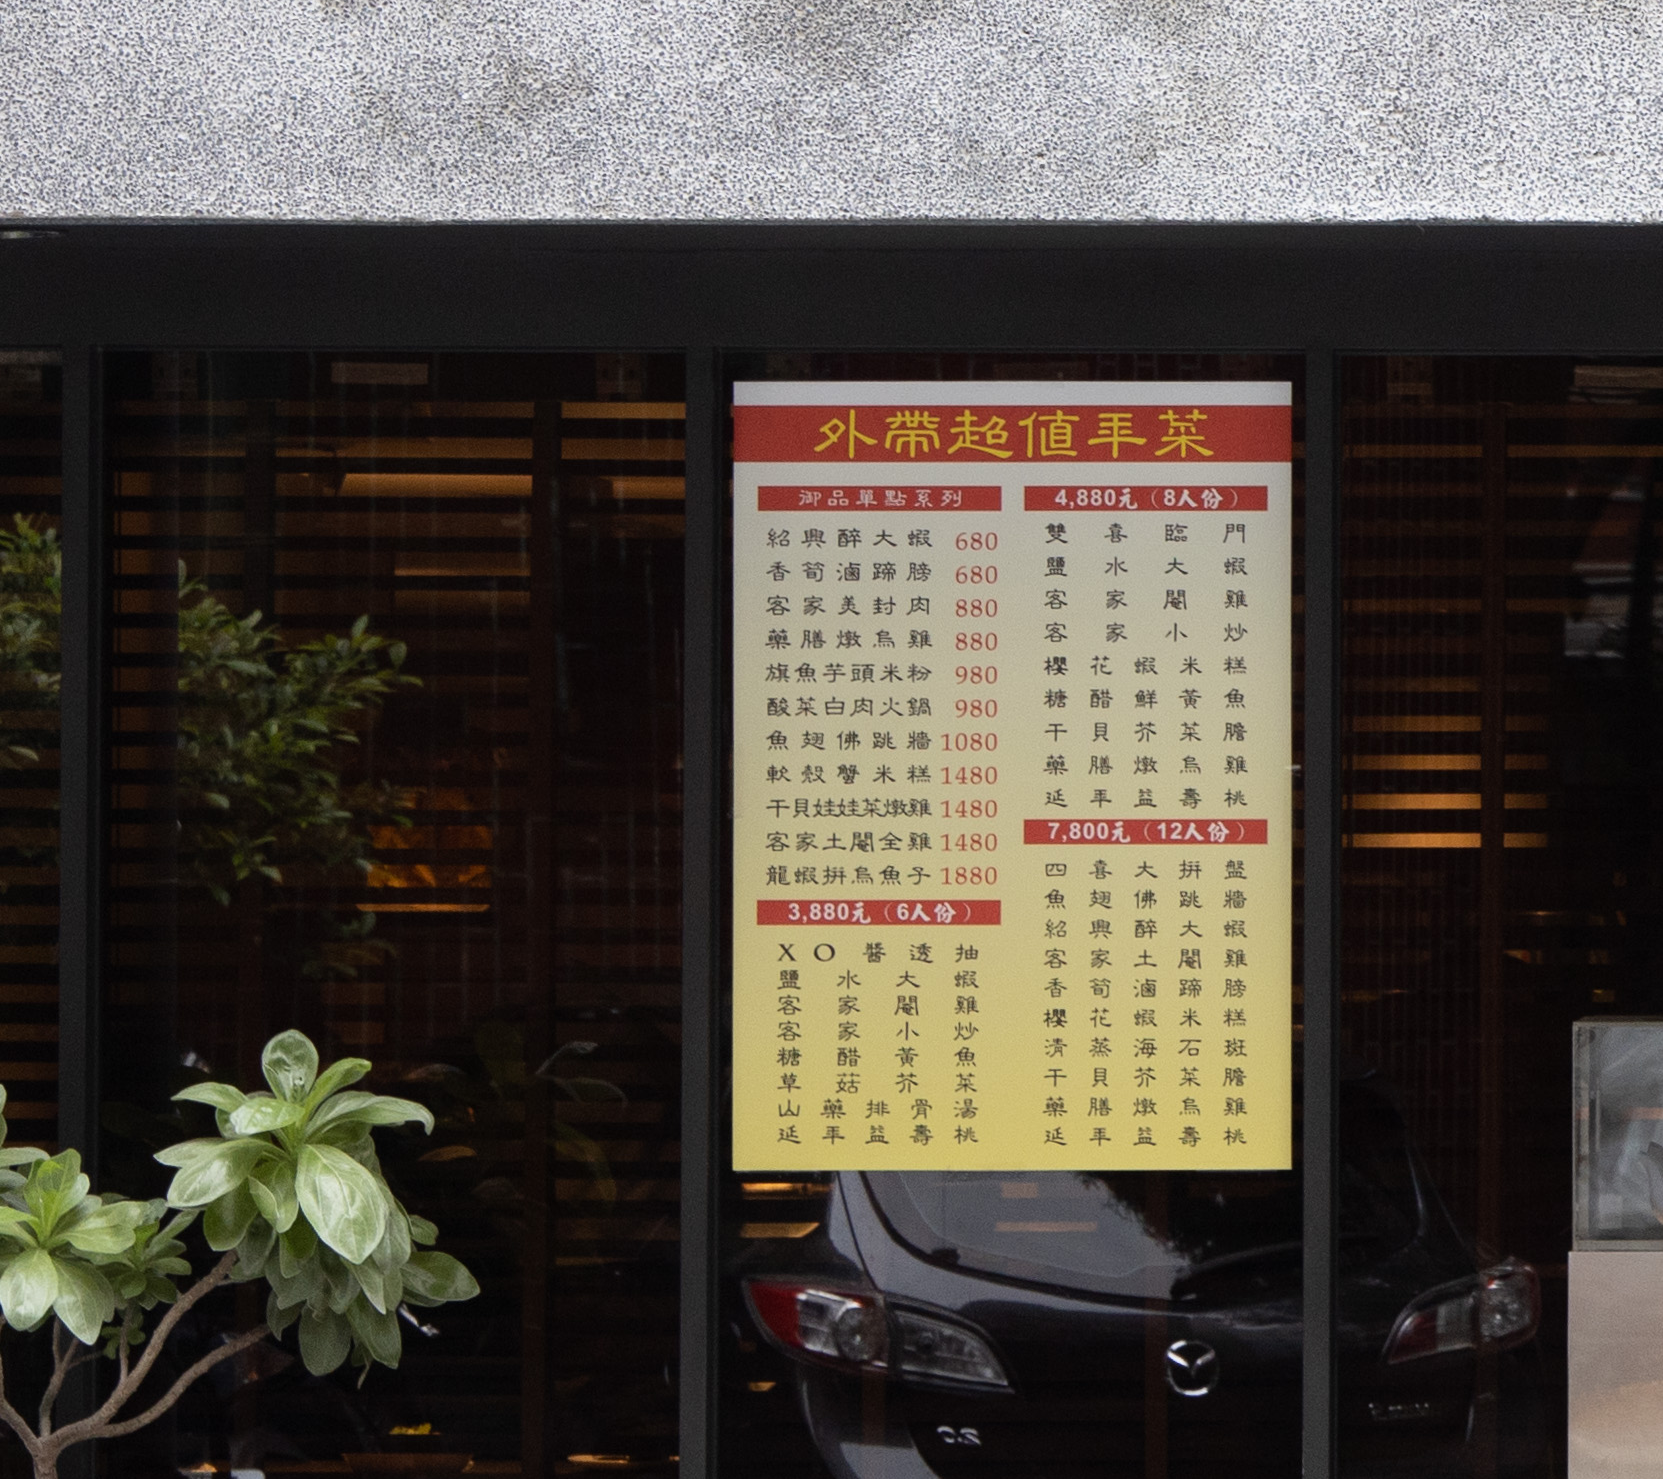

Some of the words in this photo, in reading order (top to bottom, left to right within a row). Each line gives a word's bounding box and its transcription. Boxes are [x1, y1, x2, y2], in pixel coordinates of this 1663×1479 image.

[813, 409, 1214, 459] 外帶超值年菜
[798, 489, 963, 508] 御品單點系列
[766, 528, 933, 548] 紹興醉大蝦
[954, 531, 999, 550] 680
[1045, 522, 1246, 544] 雙喜臨門
[766, 561, 932, 583] 香筍滷蹄膀
[954, 564, 999, 585] 680
[1043, 556, 1248, 577] 鹽水大蝦
[765, 595, 930, 616] 客家美封肉
[954, 598, 999, 618] 880
[764, 628, 933, 650] 藥膳燉烏雞
[954, 631, 999, 652] 880
[1043, 622, 1248, 643] 客家小炒
[765, 662, 933, 683] 旗魚芋頭米粉
[954, 665, 999, 685] 980
[1043, 655, 1247, 676] 櫻花蝦米糕
[766, 696, 932, 717] 酸菜白肉火鍋
[954, 699, 999, 719] 980
[1043, 688, 1246, 710] 糖醋鮮黃魚
[766, 729, 932, 751] 魚翅佛跳牆
[940, 732, 999, 753] 1080
[1044, 721, 1248, 743] 干貝芥菜膽
[766, 764, 932, 785] 軟殼蟹米糕
[940, 767, 999, 787] 1480
[1042, 754, 1249, 776] 藥膳燉烏雞
[766, 797, 933, 819] 干貝娃娃菜燉雞
[940, 800, 999, 821] 1480
[1044, 787, 1248, 810] 延年益壽桃
[940, 834, 999, 855] 1480
[766, 865, 931, 886] 龍蝦拼烏魚子
[940, 868, 999, 888] 1880
[1044, 859, 1248, 880] 四喜大拼盤
[1044, 888, 1248, 910] 魚翅佛跳牆
[1044, 918, 1248, 939] 紹興醉大蝦
[777, 969, 980, 990] 鹽水大蝦
[1042, 1007, 1247, 1028] 櫻花蝦米糕
[776, 1020, 979, 1042] 客家小炒
[776, 1046, 977, 1068] 糖醋黃魚
[1044, 1036, 1248, 1059] 清蒸海石斑
[777, 1072, 978, 1094] 草菇芥菜
[1043, 1066, 1247, 1088] 干貝芥菜膽
[778, 1098, 979, 1120] 山藥排骨湯
[1042, 1096, 1248, 1118] 藥膳燉烏雞
[777, 1124, 979, 1146] 延年益壽桃
[1044, 1126, 1247, 1147] 延年益壽桃
